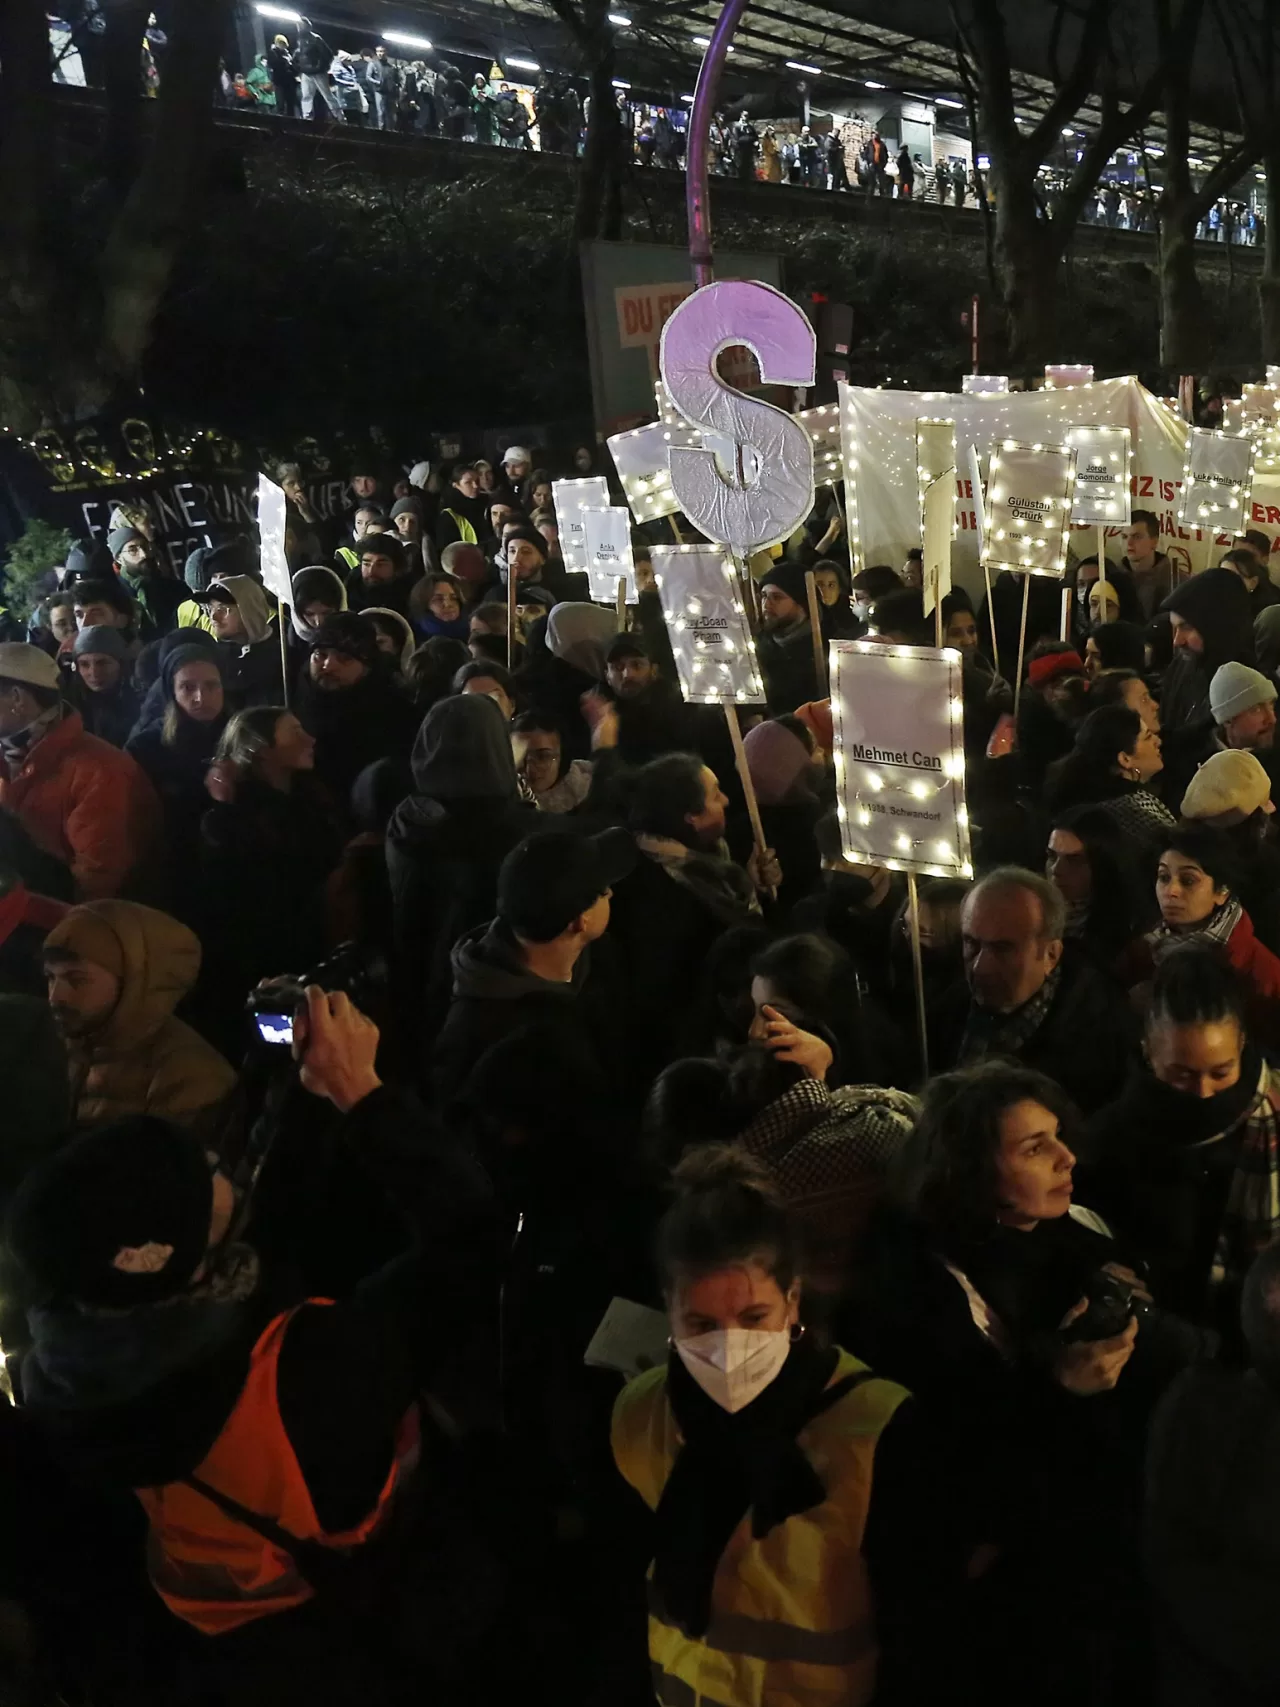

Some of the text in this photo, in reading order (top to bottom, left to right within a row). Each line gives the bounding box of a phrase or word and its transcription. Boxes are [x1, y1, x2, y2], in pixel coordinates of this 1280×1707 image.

[623, 296, 652, 335] DU
[1086, 464, 1107, 473] Jorge
[1012, 507, 1043, 521] Öztürk
[853, 744, 942, 769] Mehmet Can
[890, 806, 941, 821] Schwandorf
